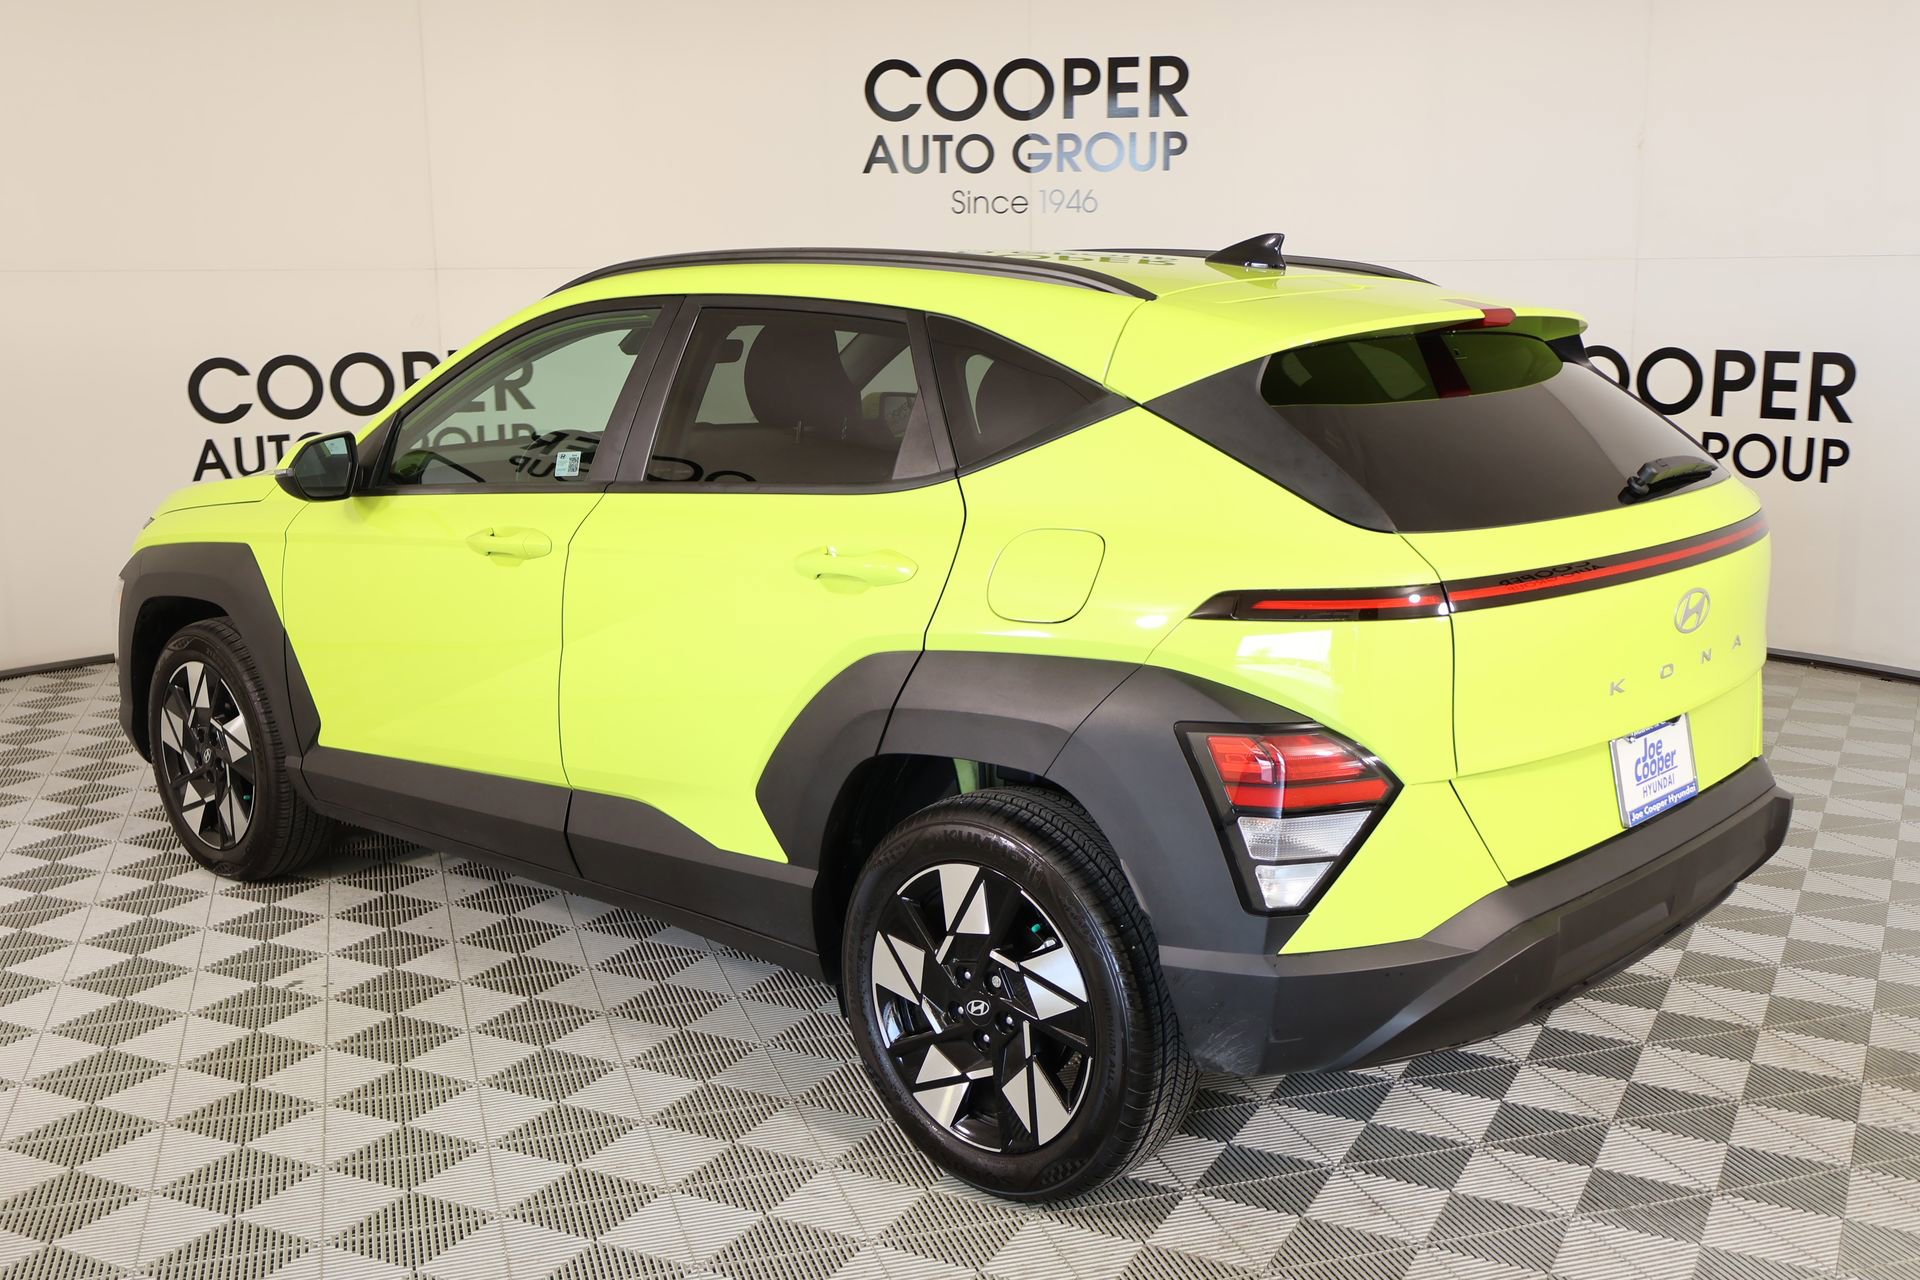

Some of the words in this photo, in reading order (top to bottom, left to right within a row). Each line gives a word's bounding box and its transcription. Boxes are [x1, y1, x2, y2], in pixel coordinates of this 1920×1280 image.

[864, 55, 1190, 122] COOPER
[863, 133, 995, 174] AUTO
[1012, 131, 1188, 174] GROUP
[951, 189, 1029, 214] Since
[1039, 188, 1098, 213] 1946
[1609, 634, 1742, 696] KONA
[1635, 750, 1676, 782] Cooper
[1642, 737, 1663, 762] Joe
[1631, 810, 1644, 822] Joe
[1643, 798, 1668, 816] Cooper
[1668, 784, 1696, 803] Hyundai
[1643, 774, 1675, 798] HYUNDAI
